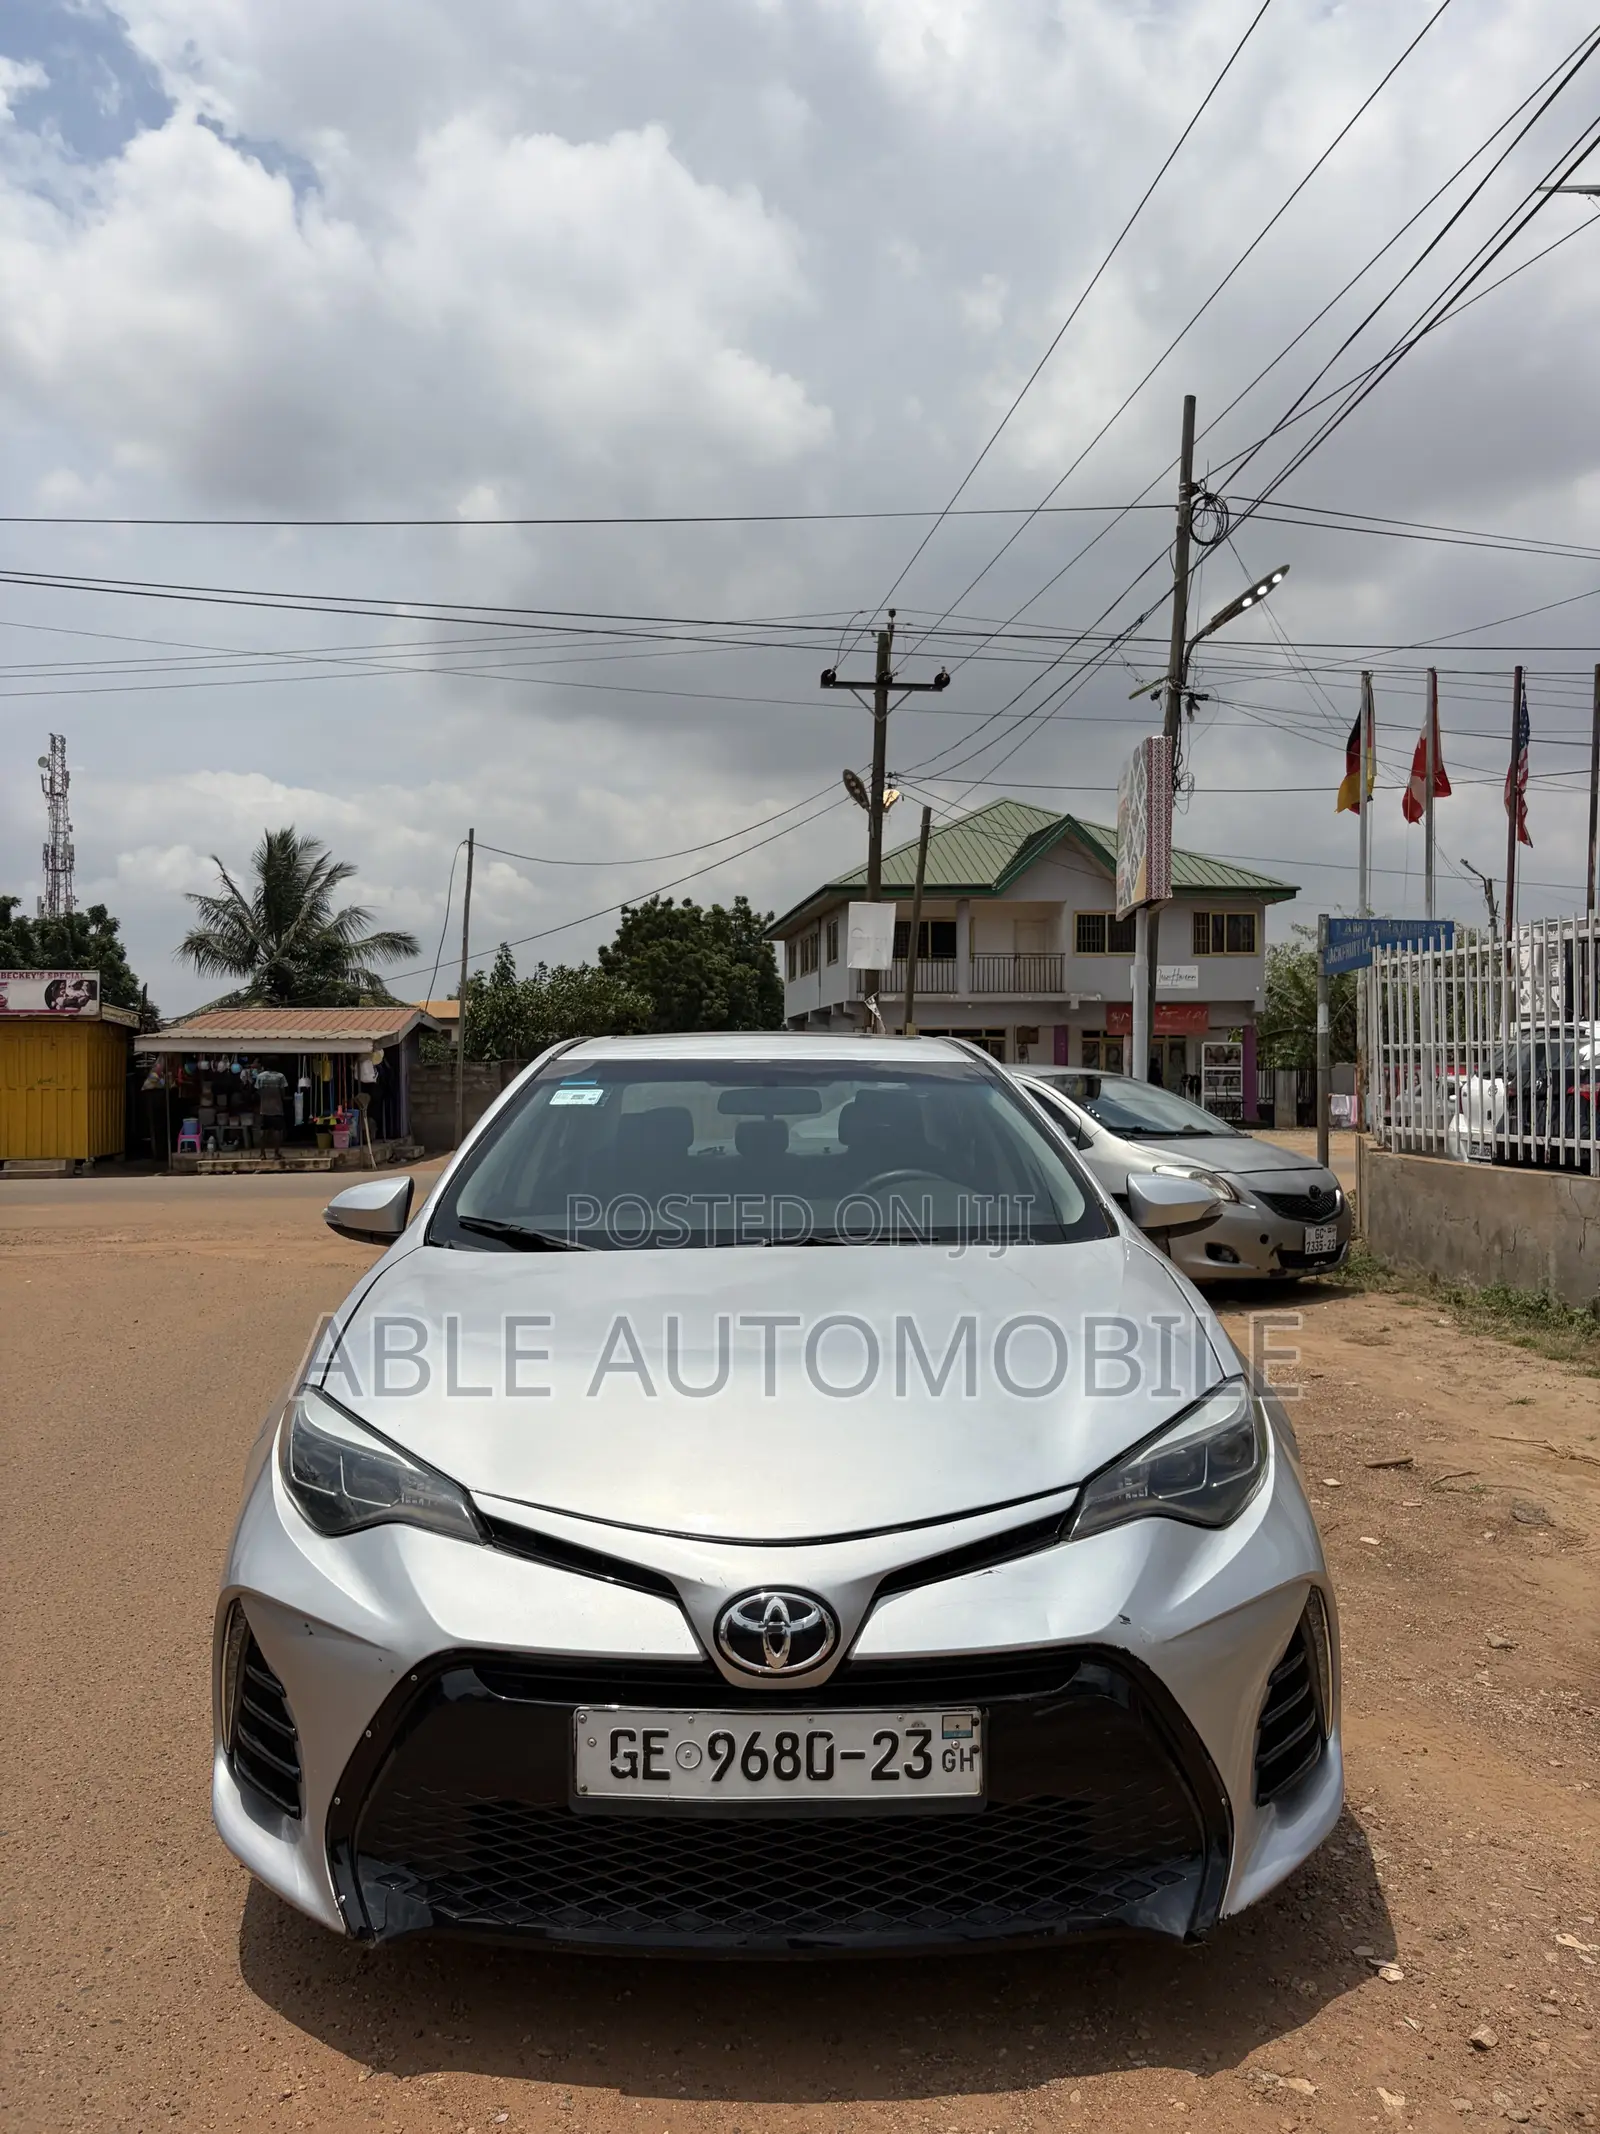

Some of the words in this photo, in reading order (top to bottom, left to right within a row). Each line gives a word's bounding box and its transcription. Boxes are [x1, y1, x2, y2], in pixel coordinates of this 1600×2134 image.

[0, 971, 45, 979] BECKEY'S
[47, 971, 84, 979] SPECIAL
[609, 1728, 671, 1781] GE
[706, 1728, 934, 1783] 9680-23
[941, 1748, 976, 1774] GH
